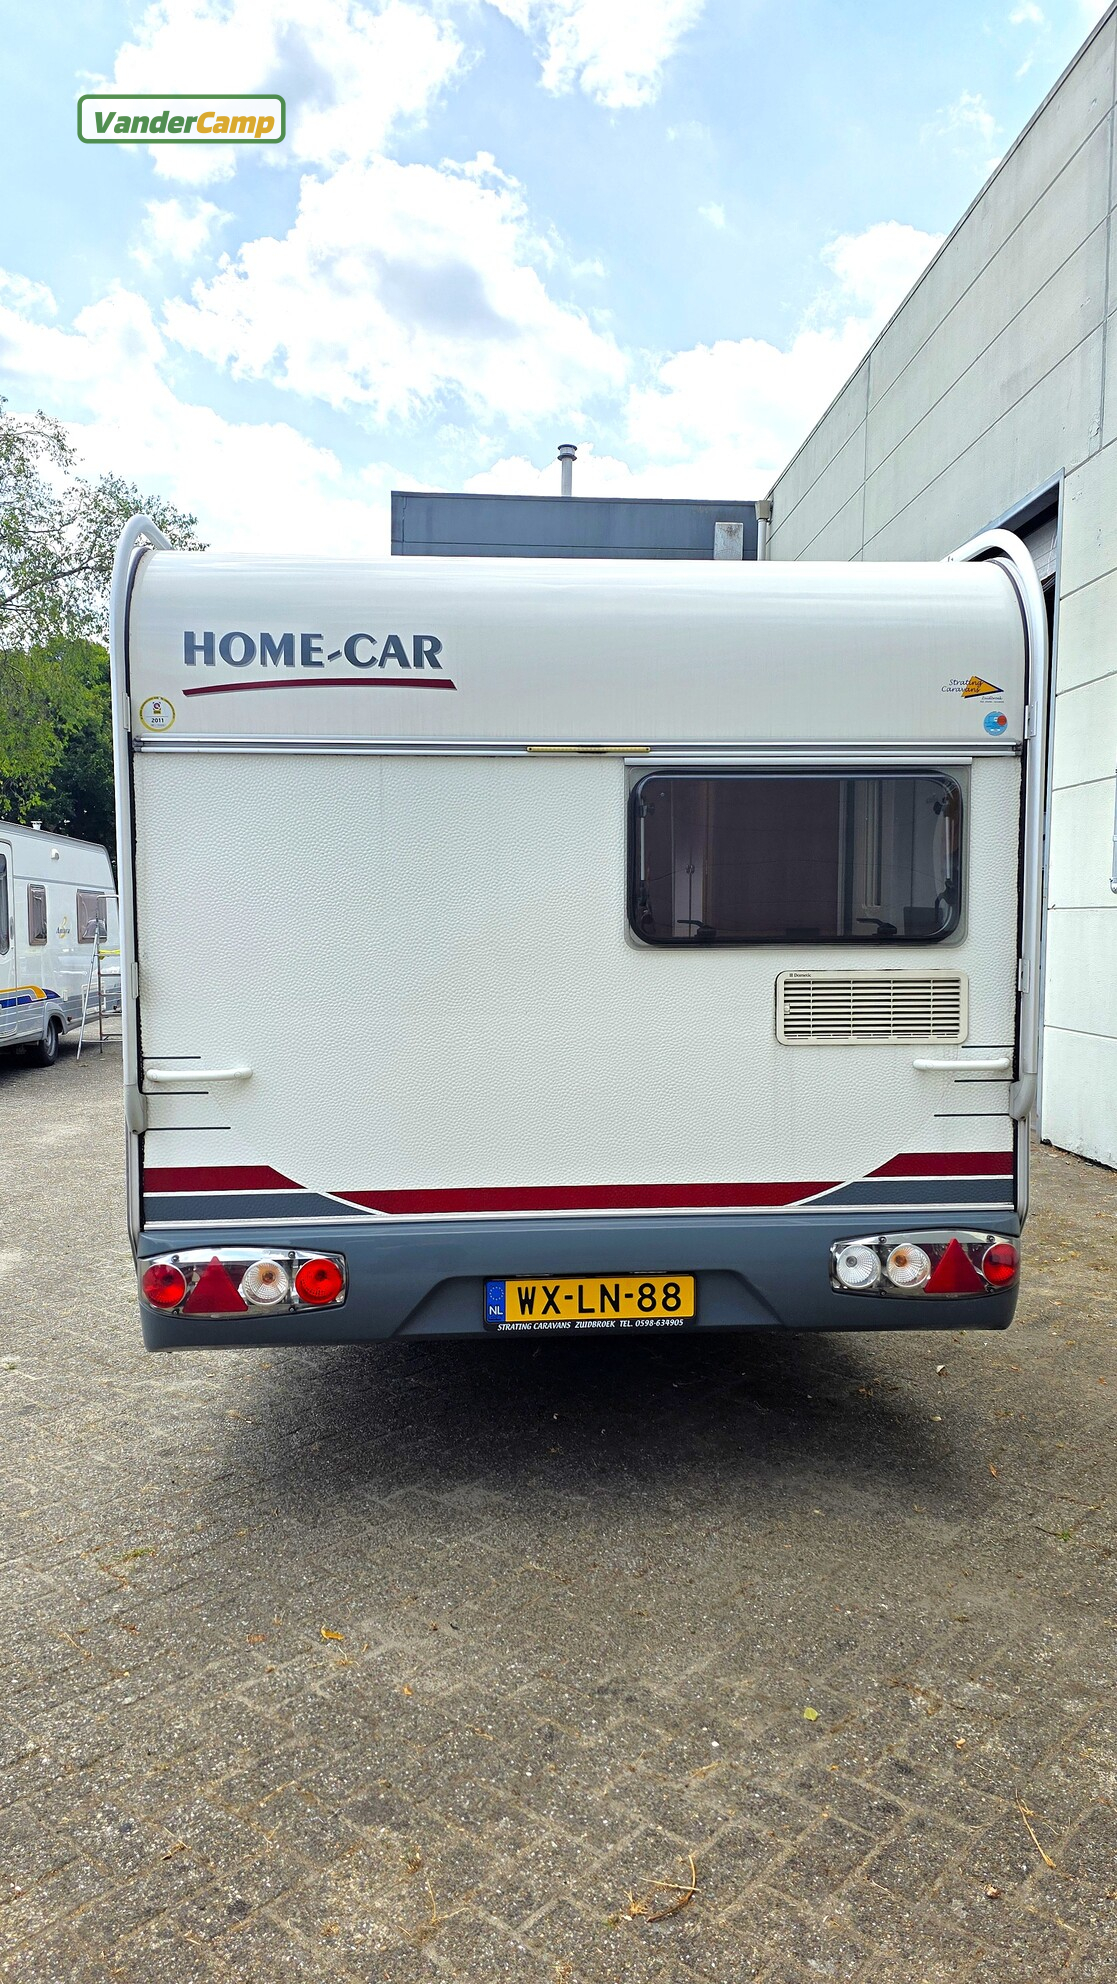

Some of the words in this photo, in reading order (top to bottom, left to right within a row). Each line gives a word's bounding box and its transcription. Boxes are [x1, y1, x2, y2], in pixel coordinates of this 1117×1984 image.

[183, 630, 445, 670] HOME-CAR
[941, 685, 981, 693] Caravans
[949, 679, 983, 687] Strating
[517, 1282, 682, 1316] WX-LN-88
[488, 1305, 504, 1316] NL
[497, 1322, 532, 1332] STRATING
[533, 1321, 572, 1330] CARAVANS
[574, 1320, 616, 1329] ZUIDBROEK
[619, 1319, 634, 1328] TEL.
[634, 1318, 685, 1328] 0598-634905
